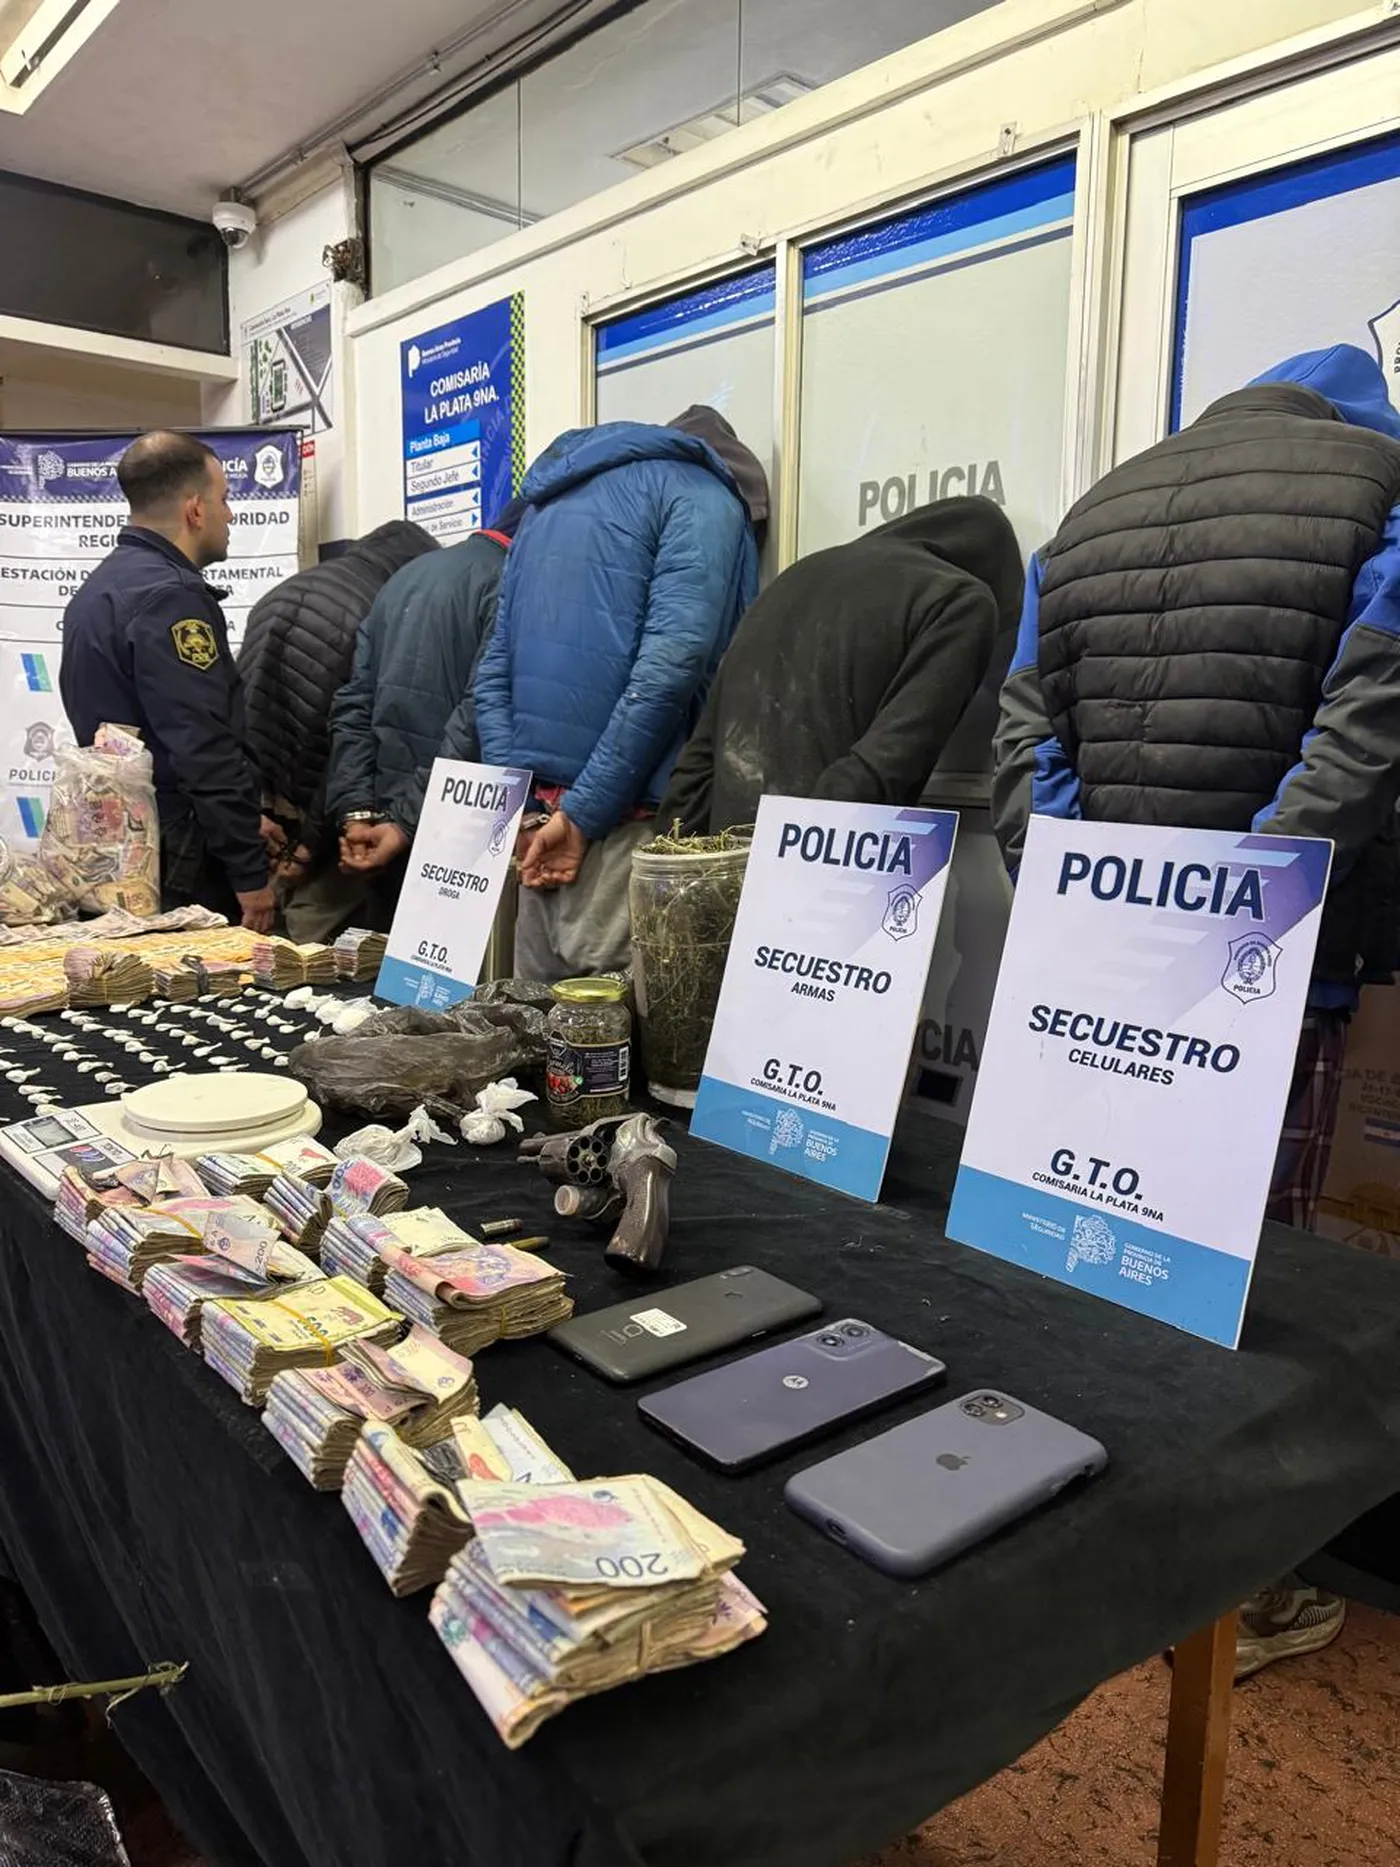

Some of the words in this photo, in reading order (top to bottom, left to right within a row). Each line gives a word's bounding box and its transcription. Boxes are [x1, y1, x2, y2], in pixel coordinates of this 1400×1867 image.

[430, 361, 490, 397] COMISARÍA
[424, 404, 439, 424] LA
[439, 393, 472, 419] PLATA
[410, 438, 432, 453] Planta
[433, 431, 450, 447] Baja
[67, 467, 107, 477] BUENOS
[221, 457, 248, 472] ICÍA
[411, 459, 434, 473] Titular
[411, 476, 442, 493] Segundo
[443, 470, 459, 485] Jefe
[859, 460, 1006, 526] POLICIA
[230, 512, 290, 526] URIDAD
[79, 534, 117, 547] REGI
[1, 566, 76, 581] ESTACIÓN
[203, 567, 283, 581] RTAMENTAL
[9, 769, 56, 781] POLICI
[441, 777, 509, 812] POLICIA
[778, 823, 913, 876] POLICIA
[421, 863, 489, 893] SECUESTRO
[1056, 851, 1266, 921] POLICIA
[438, 886, 461, 900] DROGA
[417, 940, 448, 964] G.T.O.
[753, 946, 892, 994] SECUESTRO
[791, 982, 836, 1002] ARMAS
[1233, 984, 1261, 994] POLICIA
[1028, 1004, 1241, 1074] SECUESTRO
[763, 1058, 824, 1096] G.T.O.
[1068, 1048, 1175, 1086] CELULARES
[750, 1077, 787, 1095] COMISARIA
[787, 1089, 798, 1099] LA
[798, 1093, 821, 1106] PLATA
[806, 1139, 838, 1156] BUENOS
[1050, 1148, 1143, 1201] G.T.O.
[1032, 1172, 1088, 1197] COMISARIA
[1090, 1190, 1104, 1203] LA
[1105, 1195, 1139, 1214] PLATA
[1141, 1206, 1164, 1222] 9NA
[1118, 1266, 1152, 1286] AIRES
[1121, 1255, 1169, 1280] BUENOS
[595, 1553, 668, 1578] 200
